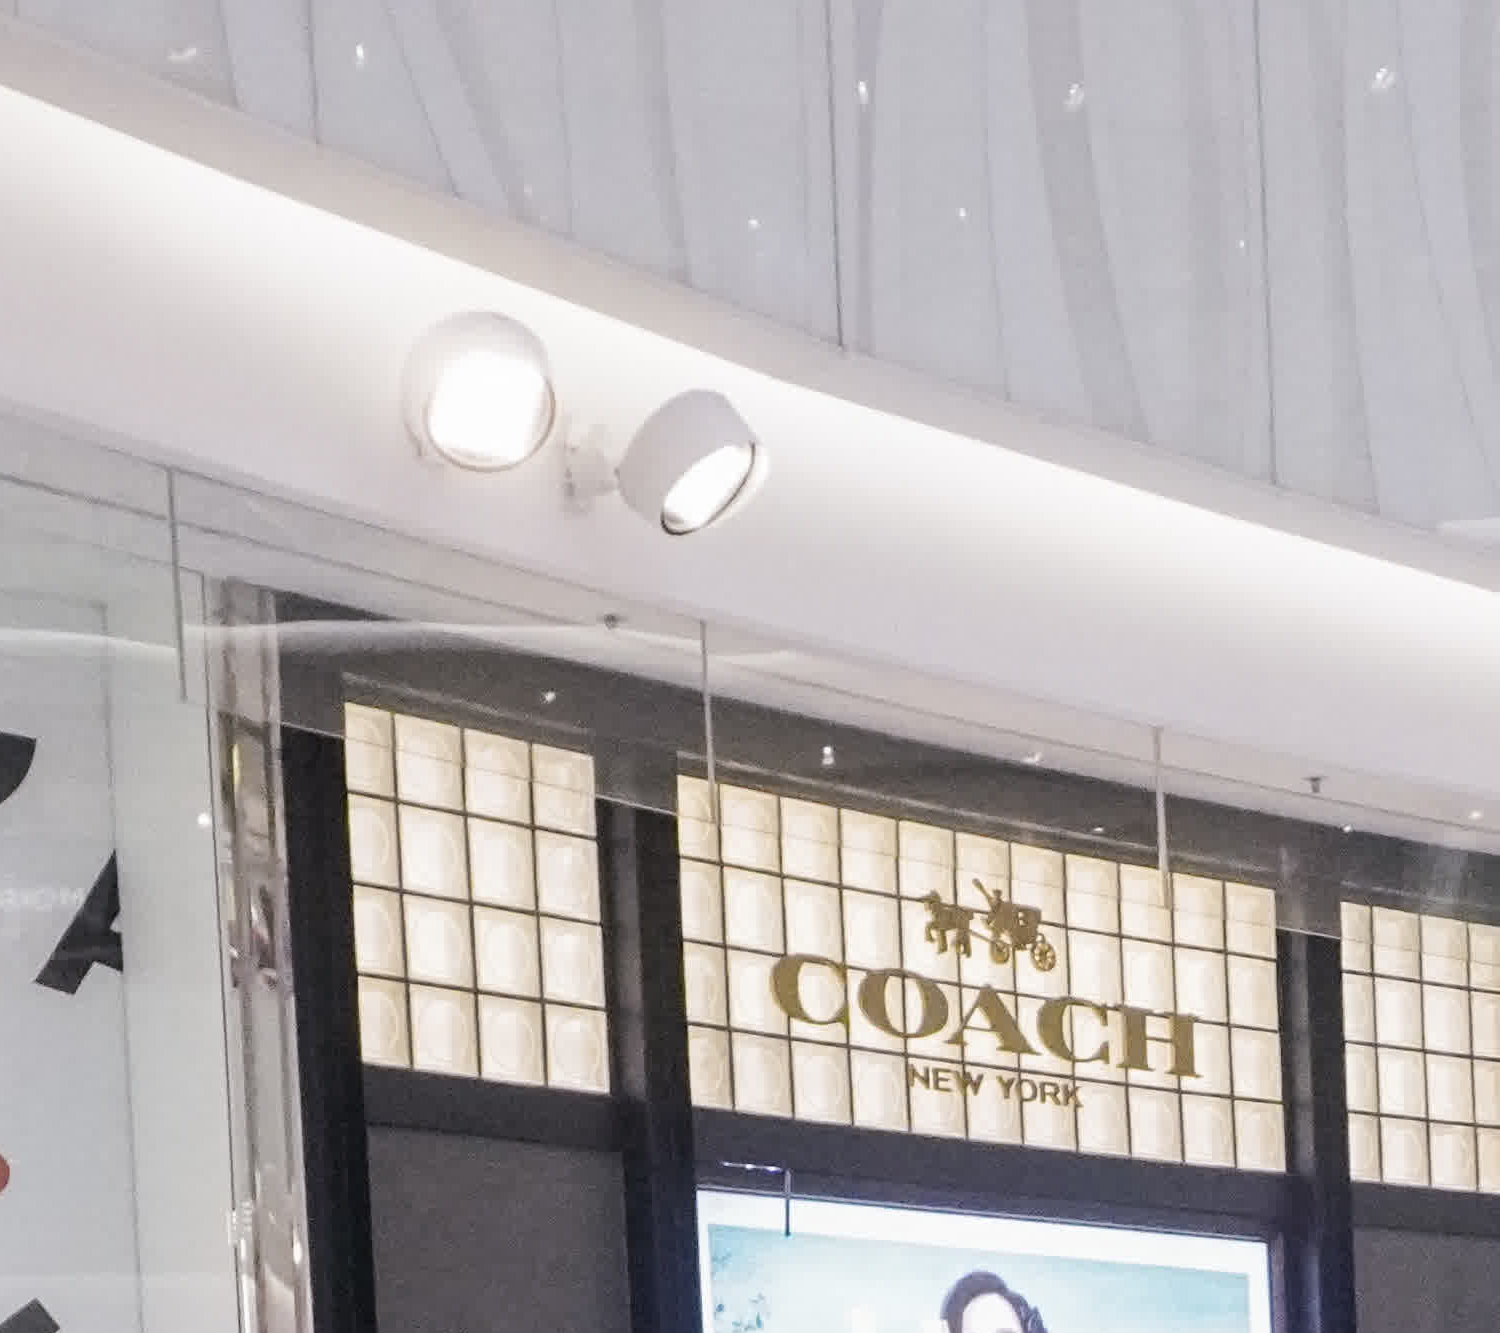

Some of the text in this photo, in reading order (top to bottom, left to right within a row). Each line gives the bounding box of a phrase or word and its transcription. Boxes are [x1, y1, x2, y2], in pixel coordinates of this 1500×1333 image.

[769, 953, 1202, 1079] COACH
[906, 1064, 1085, 1110] NEW YORK
